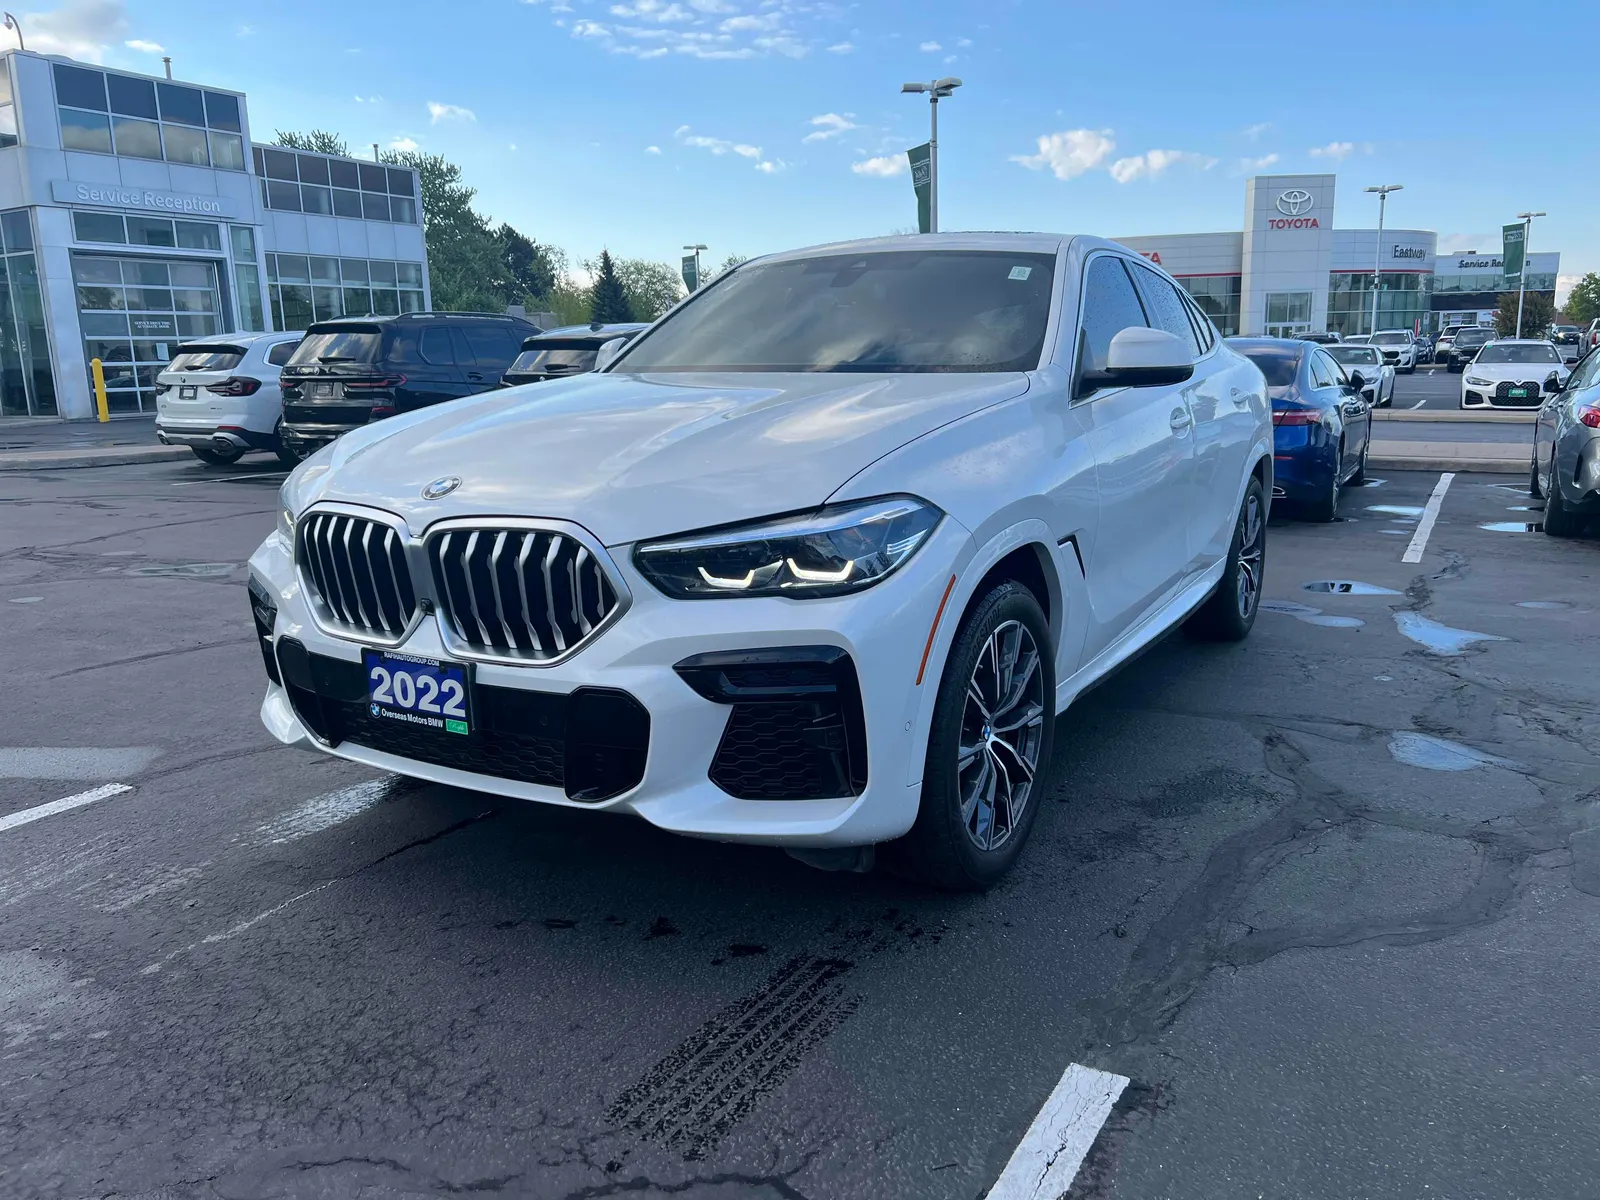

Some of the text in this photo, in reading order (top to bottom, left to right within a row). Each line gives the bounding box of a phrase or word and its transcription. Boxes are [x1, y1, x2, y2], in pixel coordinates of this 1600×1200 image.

[76, 184, 221, 213] Service Reception
[1268, 218, 1319, 230] TOYOTA
[1392, 244, 1427, 262] Eastway
[1458, 259, 1489, 268] Service
[370, 666, 466, 718] 2022
[381, 708, 408, 721] Overseas
[407, 713, 427, 725] Motors
[428, 717, 444, 728] BMW
